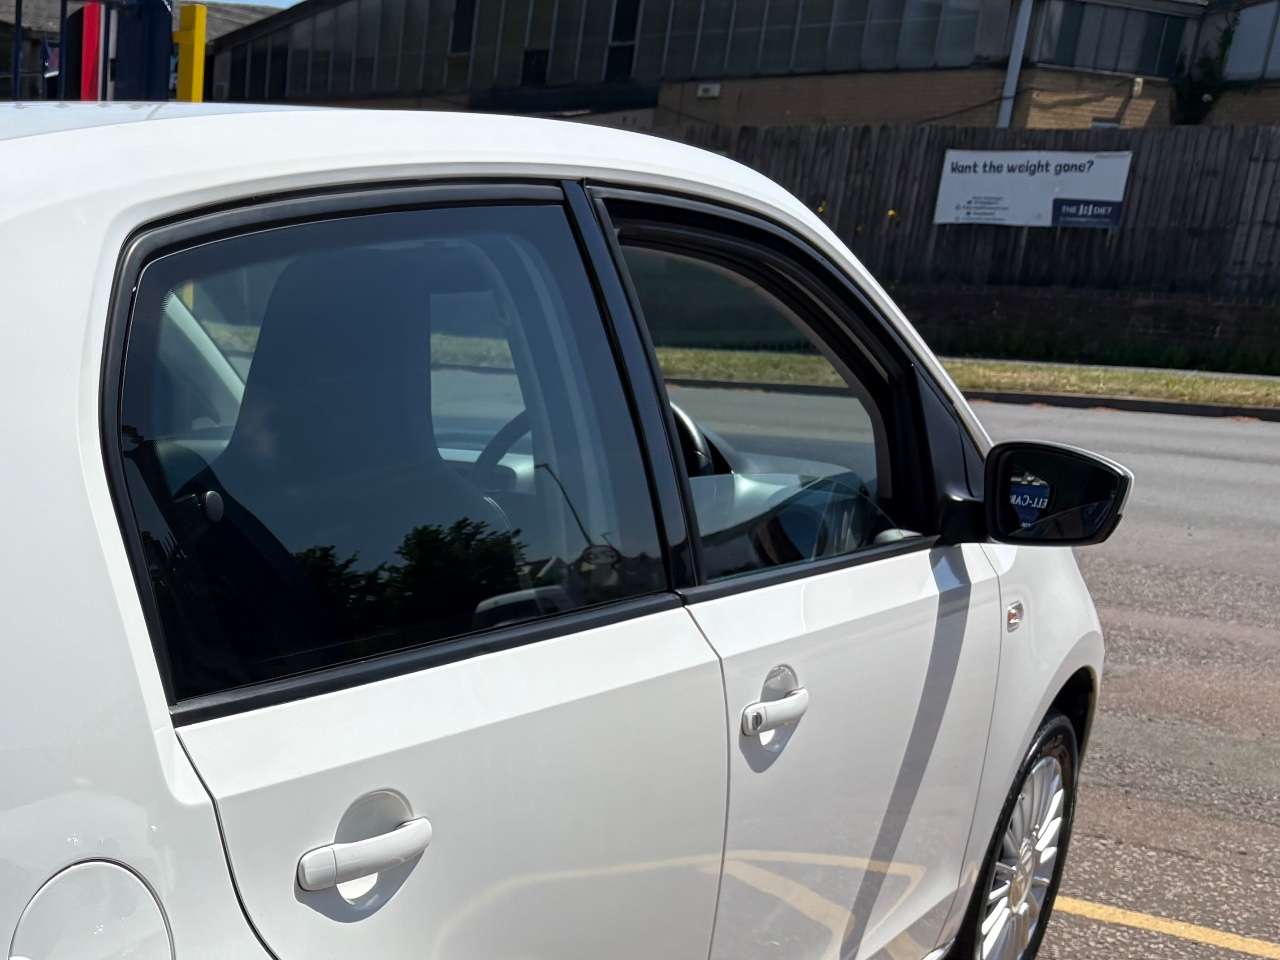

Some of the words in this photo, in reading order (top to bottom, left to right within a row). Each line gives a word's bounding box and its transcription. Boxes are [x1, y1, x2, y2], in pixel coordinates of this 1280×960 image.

[950, 161, 978, 174] Want
[982, 160, 1003, 174] the
[1007, 160, 1051, 176] weight
[1054, 159, 1095, 176] gone?
